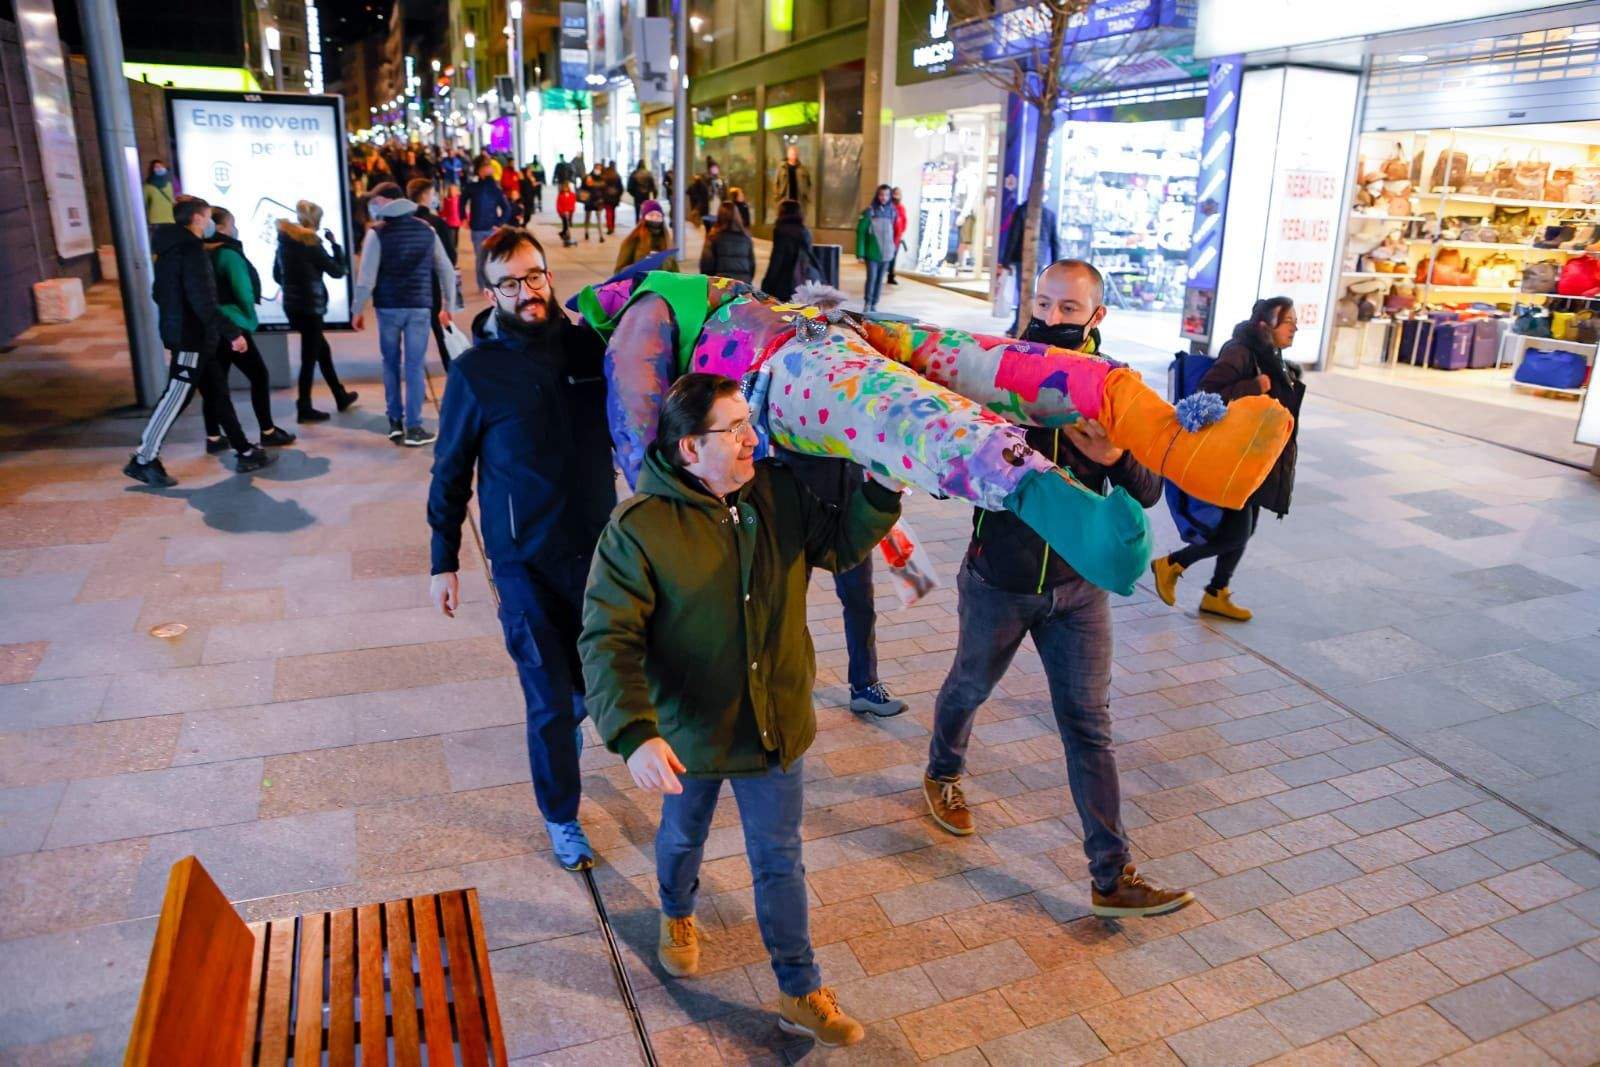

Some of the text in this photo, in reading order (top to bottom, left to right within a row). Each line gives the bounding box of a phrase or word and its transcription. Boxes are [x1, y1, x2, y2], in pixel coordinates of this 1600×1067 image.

[192, 108, 320, 130] Ens movem
[250, 141, 287, 158] pe
